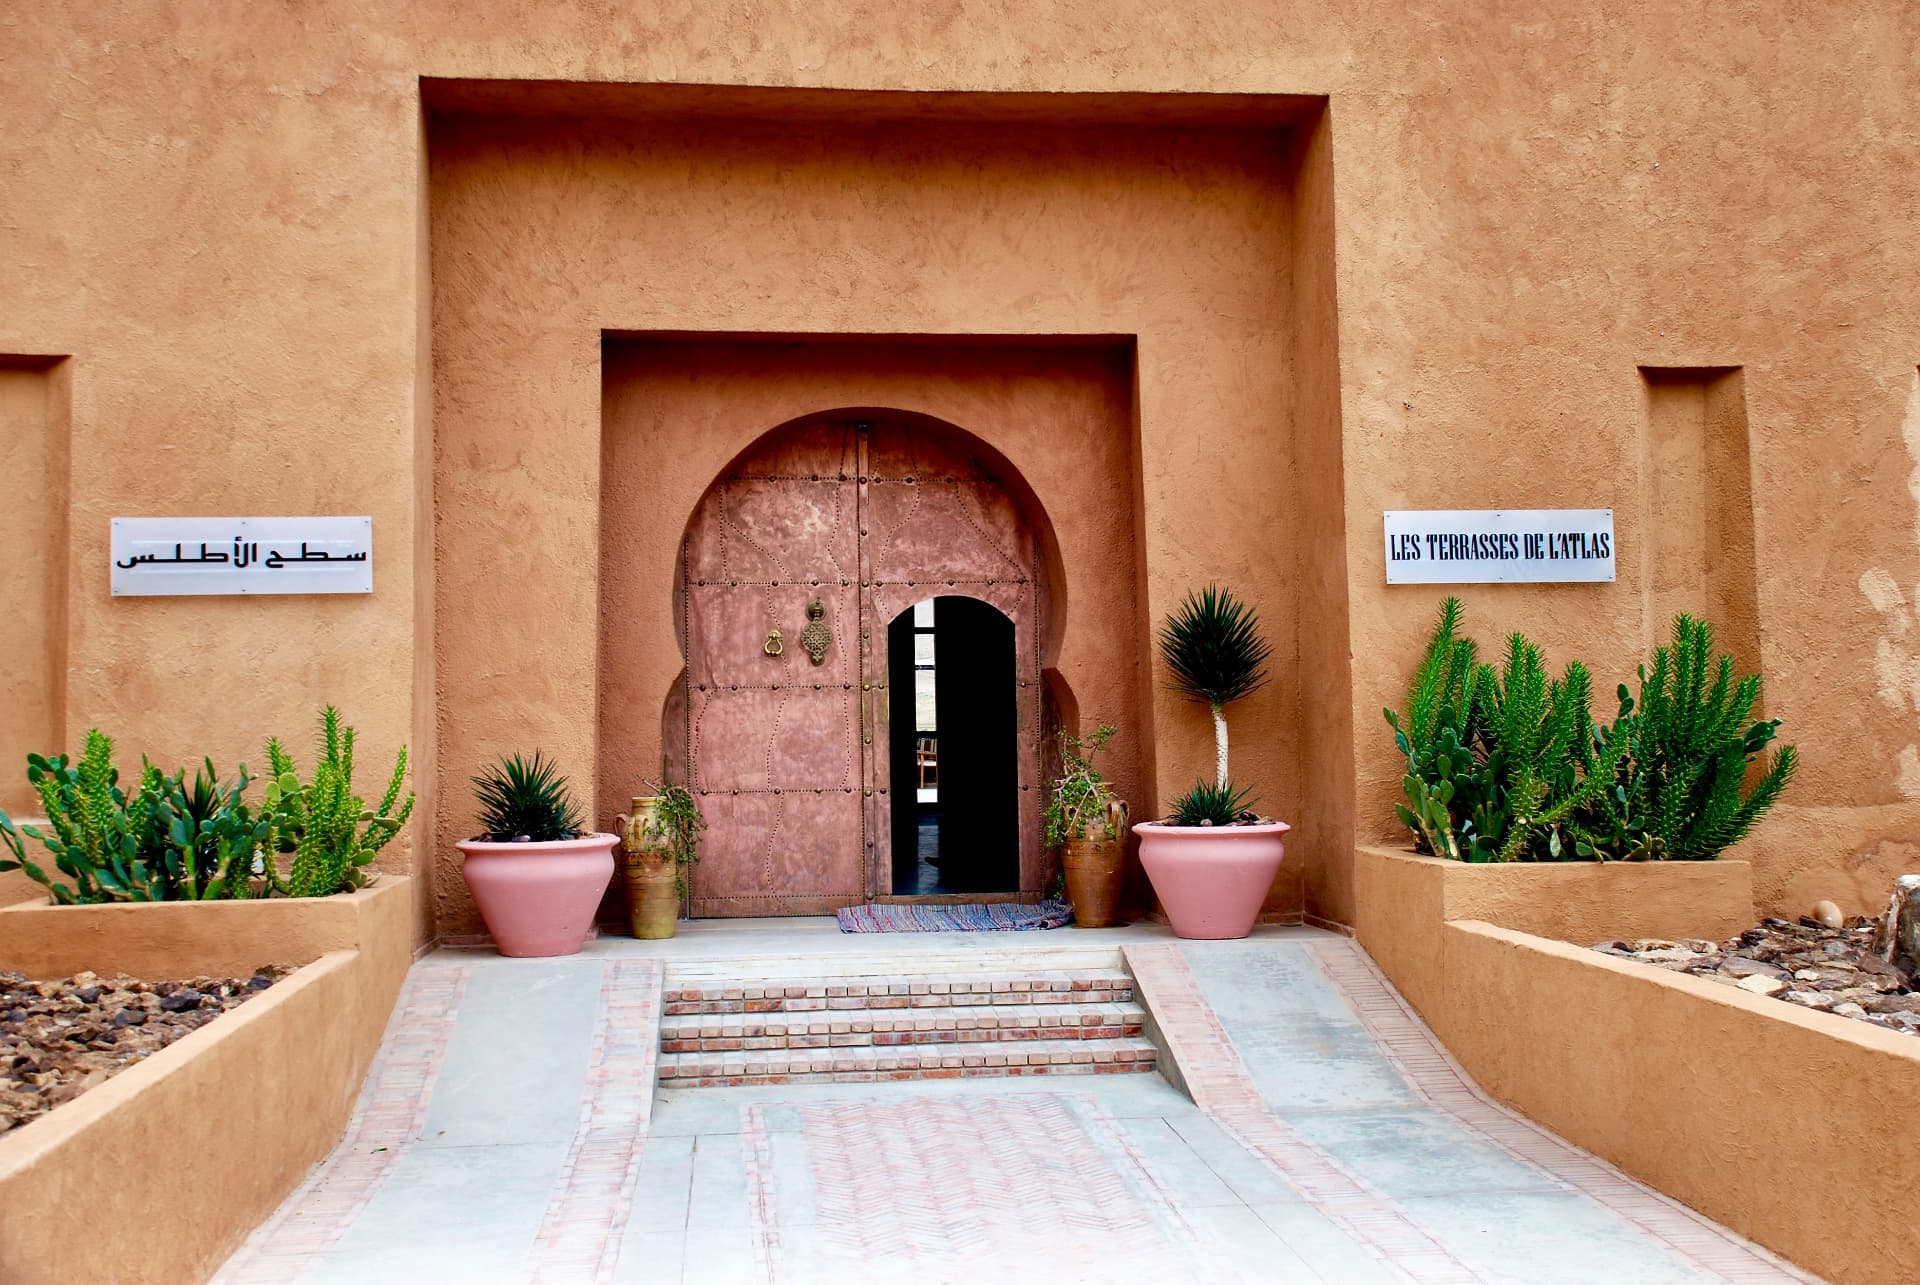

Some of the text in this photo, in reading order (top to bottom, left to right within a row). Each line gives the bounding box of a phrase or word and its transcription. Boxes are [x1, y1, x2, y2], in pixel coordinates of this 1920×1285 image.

[116, 536, 367, 569] سطح الأطلس
[1391, 532, 1610, 561] LES TERRASSES DE L'ATLAS
